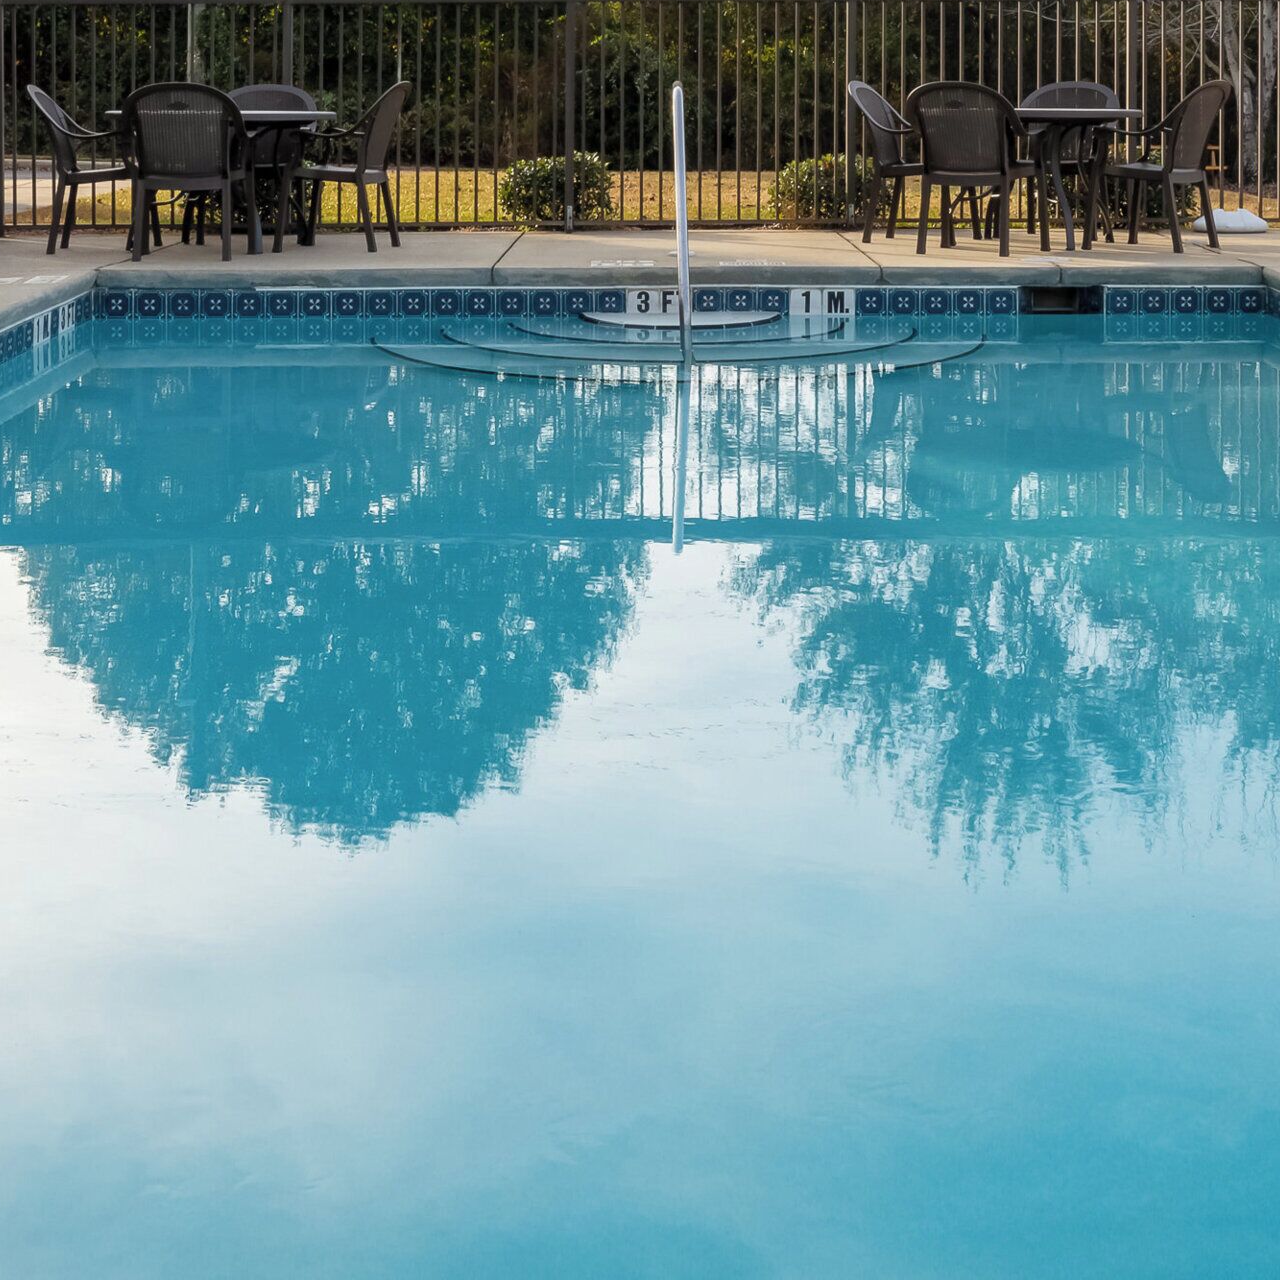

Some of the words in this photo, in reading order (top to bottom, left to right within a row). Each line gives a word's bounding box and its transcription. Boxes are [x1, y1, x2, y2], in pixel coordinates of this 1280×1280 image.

[636, 290, 650, 313] 3
[661, 291, 679, 313] F
[801, 291, 811, 313] 1
[827, 291, 850, 314] M.
